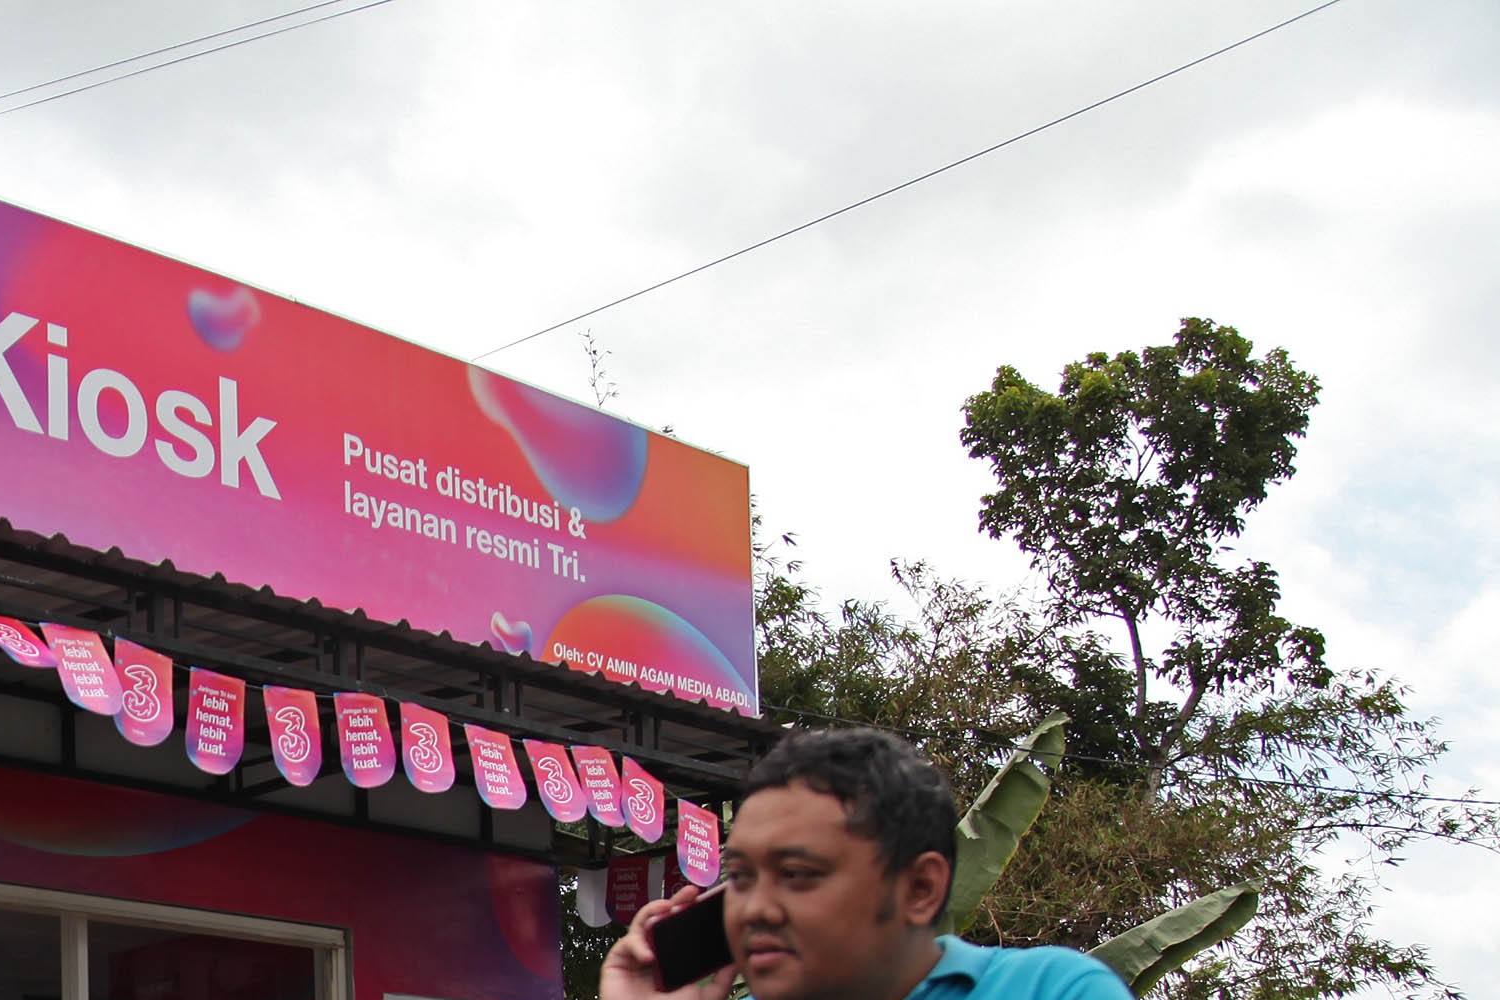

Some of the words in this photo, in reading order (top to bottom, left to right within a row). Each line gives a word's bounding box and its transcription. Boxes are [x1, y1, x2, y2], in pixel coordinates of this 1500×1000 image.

[343, 432, 428, 489] Pusat
[436, 466, 560, 530] distribusi
[567, 506, 587, 540] &
[344, 481, 457, 544] layanan
[466, 525, 540, 569] resmi
[547, 542, 586, 583] Tri.
[62, 646, 92, 659] lebih
[62, 658, 105, 674] hemat,
[72, 672, 103, 686] lebih
[553, 643, 584, 664] Oleh:
[587, 652, 604, 669] CV
[606, 657, 638, 678] AMIN
[640, 666, 675, 688] AGAM
[677, 677, 714, 698] MEDIA
[715, 686, 751, 709] ABADI.
[77, 685, 108, 698] kuat.
[203, 694, 229, 712] lebih
[196, 707, 234, 730] hemat,
[349, 715, 373, 728] lebih
[199, 724, 227, 742] lebih
[345, 729, 382, 742] hemat,
[197, 738, 226, 756] kuat.
[351, 742, 378, 755] lebih
[480, 745, 503, 761] lebih
[353, 756, 381, 769] kuat.
[477, 757, 511, 775] hemat,
[484, 771, 508, 784] lebih
[586, 765, 606, 777] lebih
[486, 782, 513, 796] kuat.
[585, 777, 614, 789] hemat,
[592, 789, 612, 800] lebih
[595, 801, 618, 812] kuat.
[688, 820, 708, 838] lebih
[684, 831, 713, 851] hemat,
[687, 844, 709, 860] lebih
[687, 856, 709, 872] kuat.
